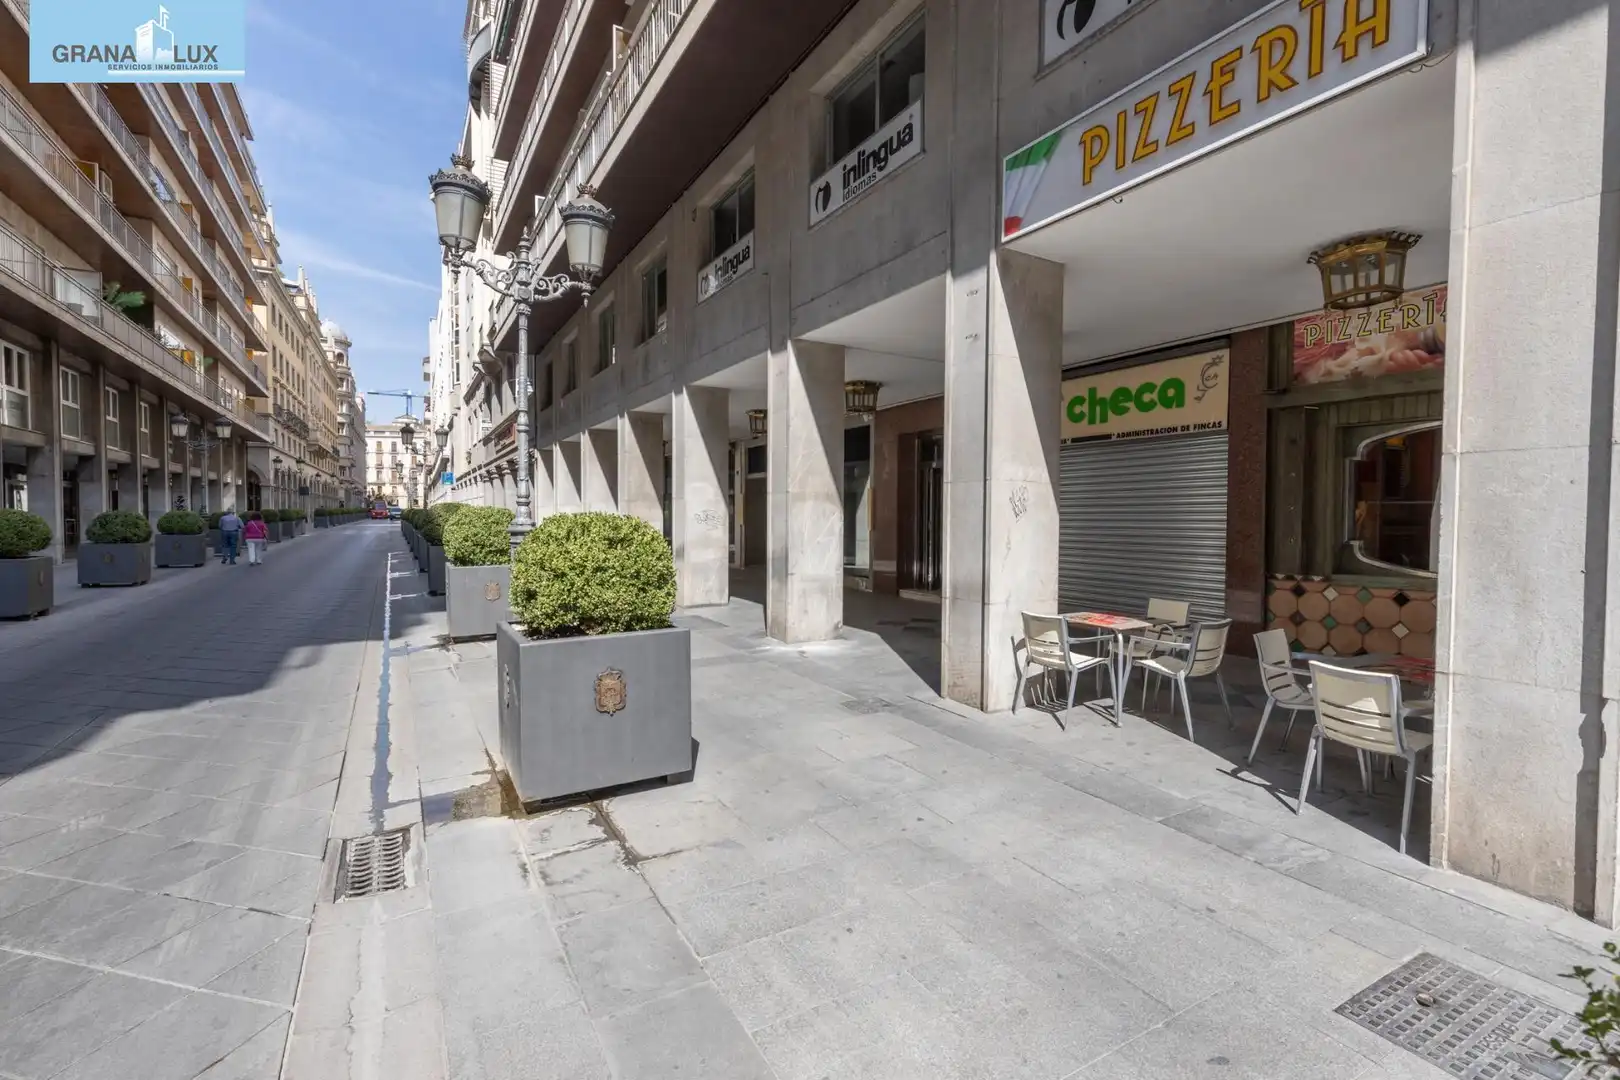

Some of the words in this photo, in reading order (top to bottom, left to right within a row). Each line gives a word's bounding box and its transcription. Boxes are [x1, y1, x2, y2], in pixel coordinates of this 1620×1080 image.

[842, 122, 914, 190] inlingua
[843, 172, 877, 203] idiomas
[715, 245, 750, 286] inlingua
[1066, 377, 1186, 425] checa
[1116, 426, 1178, 439] ADMINISTRACION
[1180, 424, 1190, 432] DE
[1193, 421, 1223, 432] FINCAS
